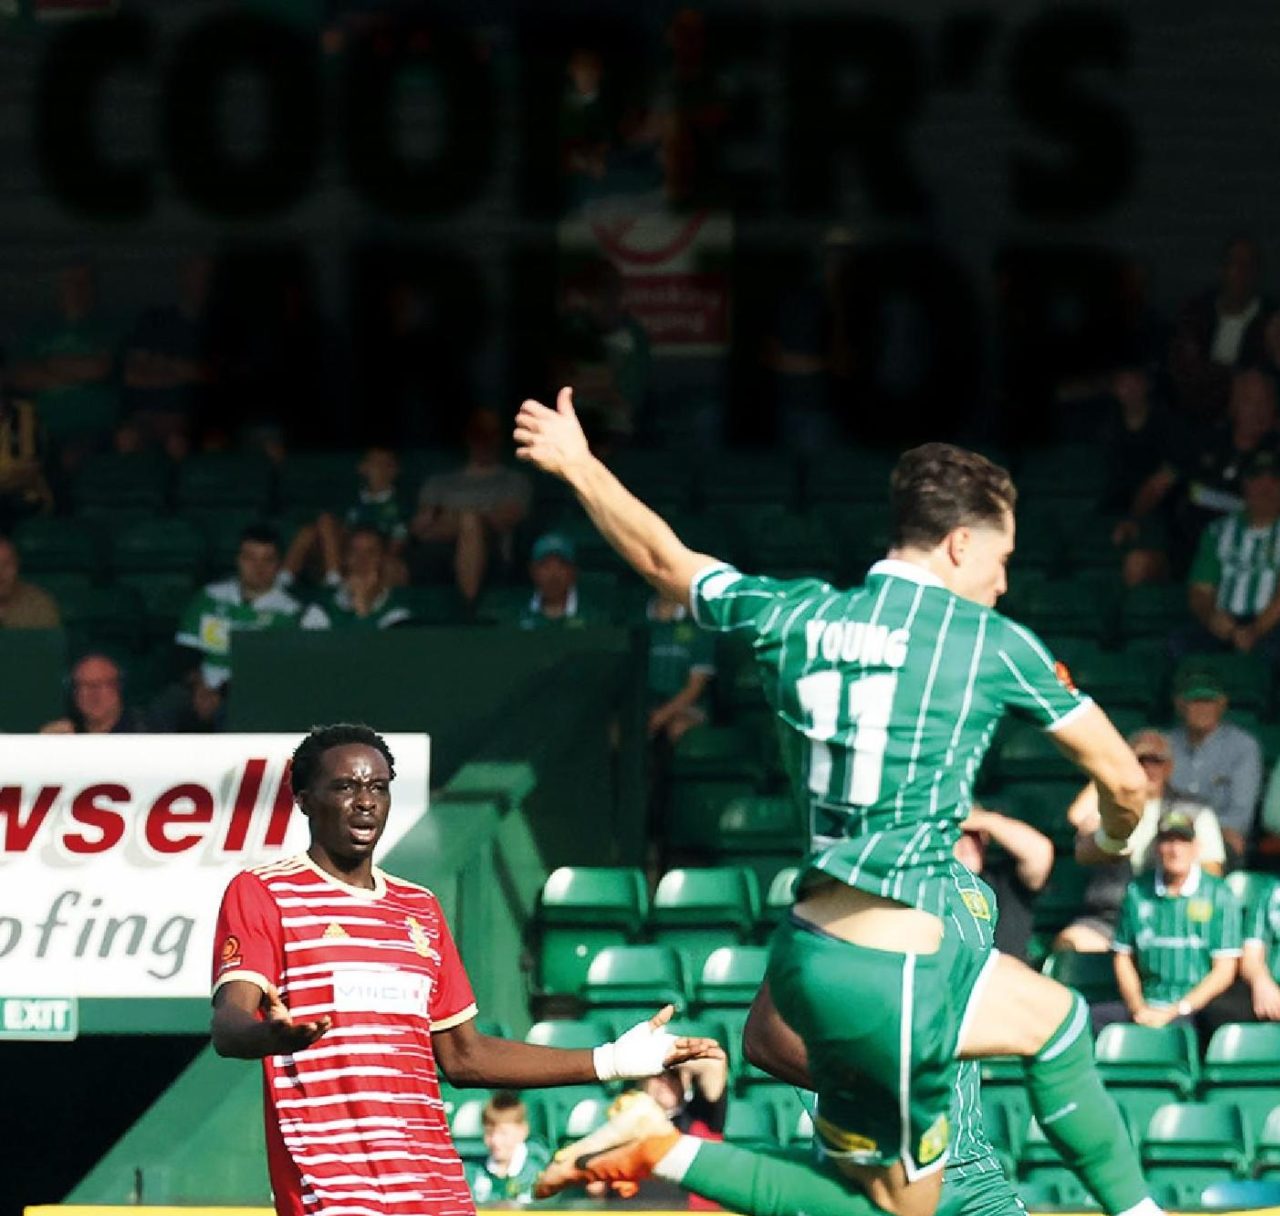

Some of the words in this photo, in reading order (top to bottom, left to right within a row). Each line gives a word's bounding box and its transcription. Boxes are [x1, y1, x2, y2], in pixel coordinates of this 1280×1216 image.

[806, 619, 910, 668] YOUNG
[796, 670, 898, 806] 11
[3, 999, 70, 1030] EXIT
